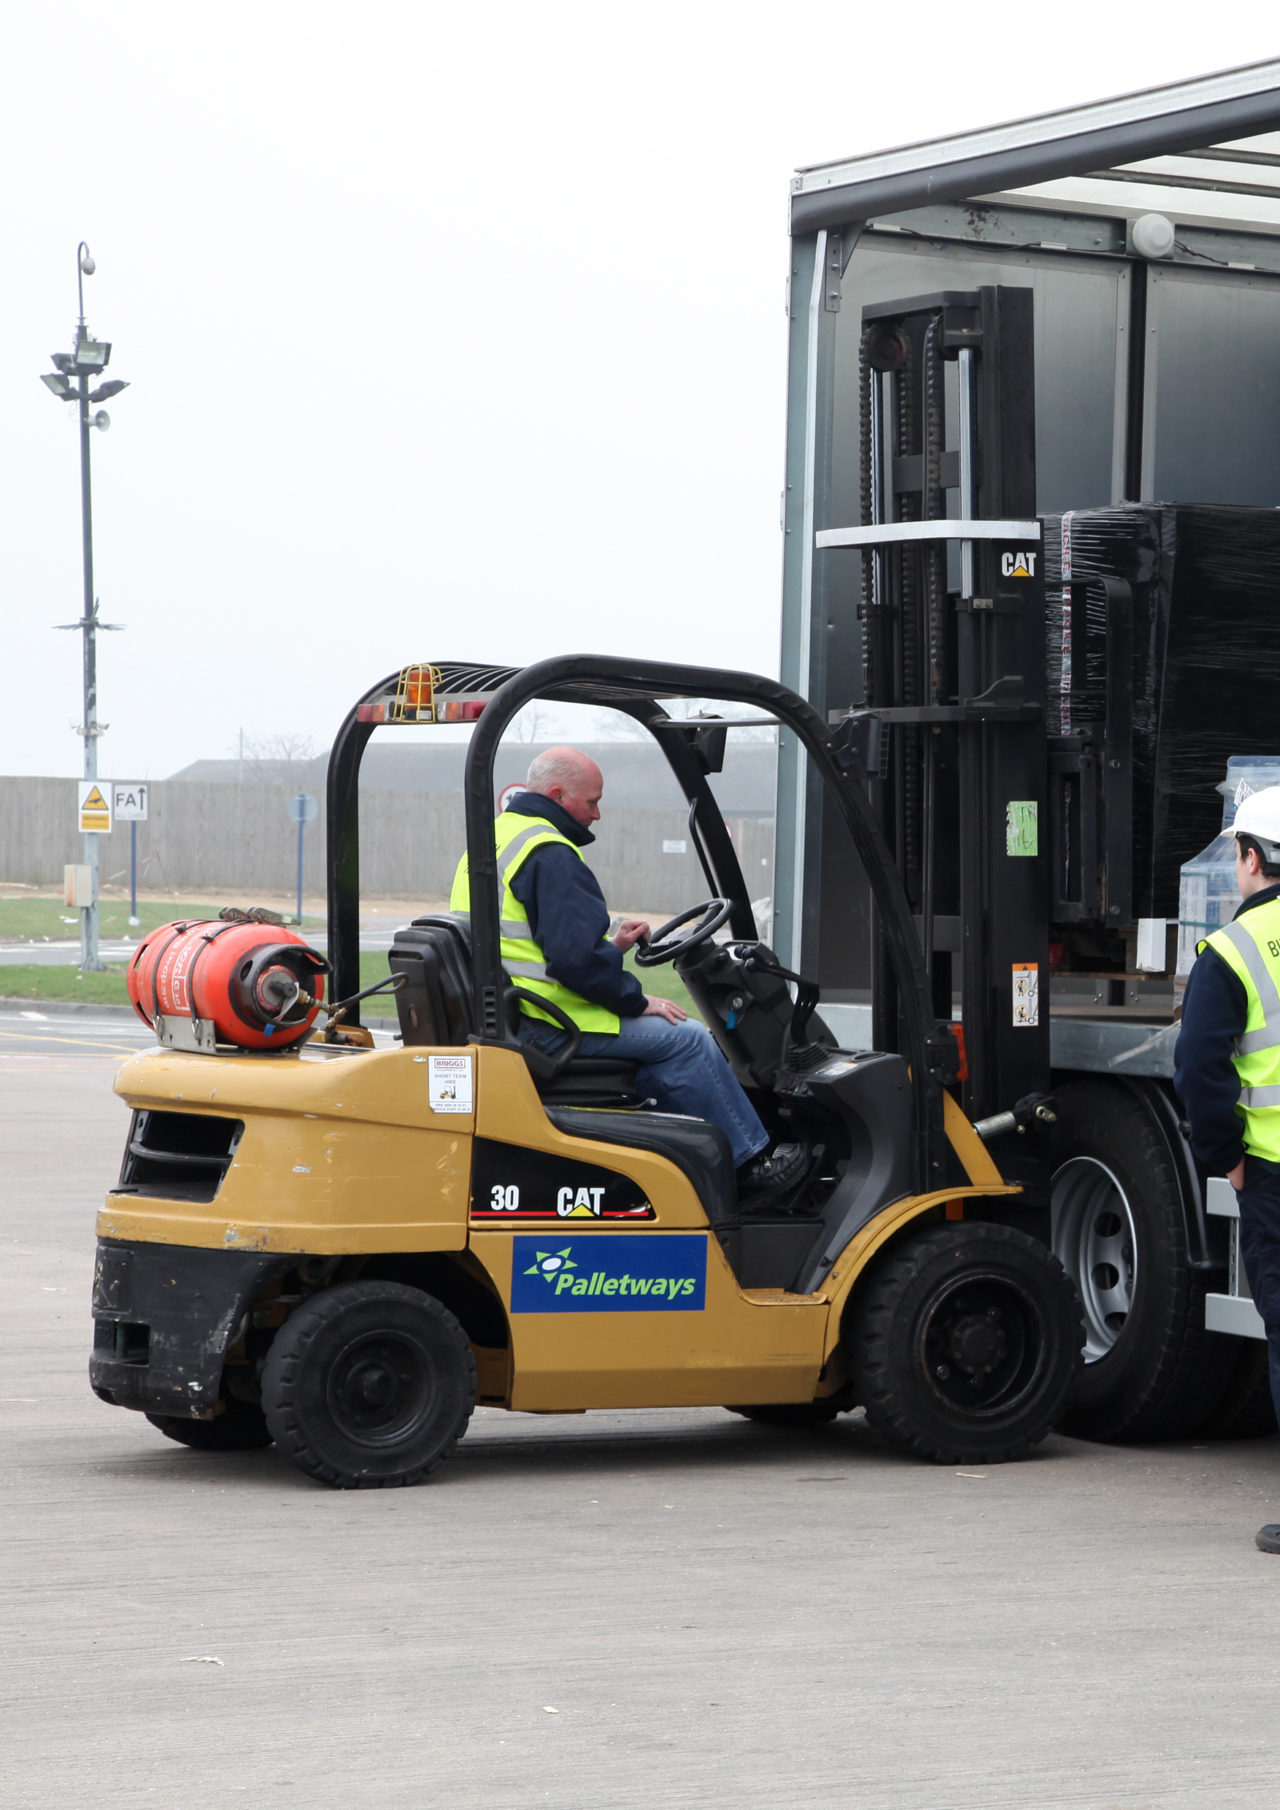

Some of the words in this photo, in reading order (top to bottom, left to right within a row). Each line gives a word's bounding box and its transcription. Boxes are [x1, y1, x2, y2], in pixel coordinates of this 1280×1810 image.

[1001, 552, 1037, 577] CAT
[490, 1184, 520, 1211] 30
[556, 1186, 606, 1218] CAT
[554, 1272, 697, 1301] Palletways
